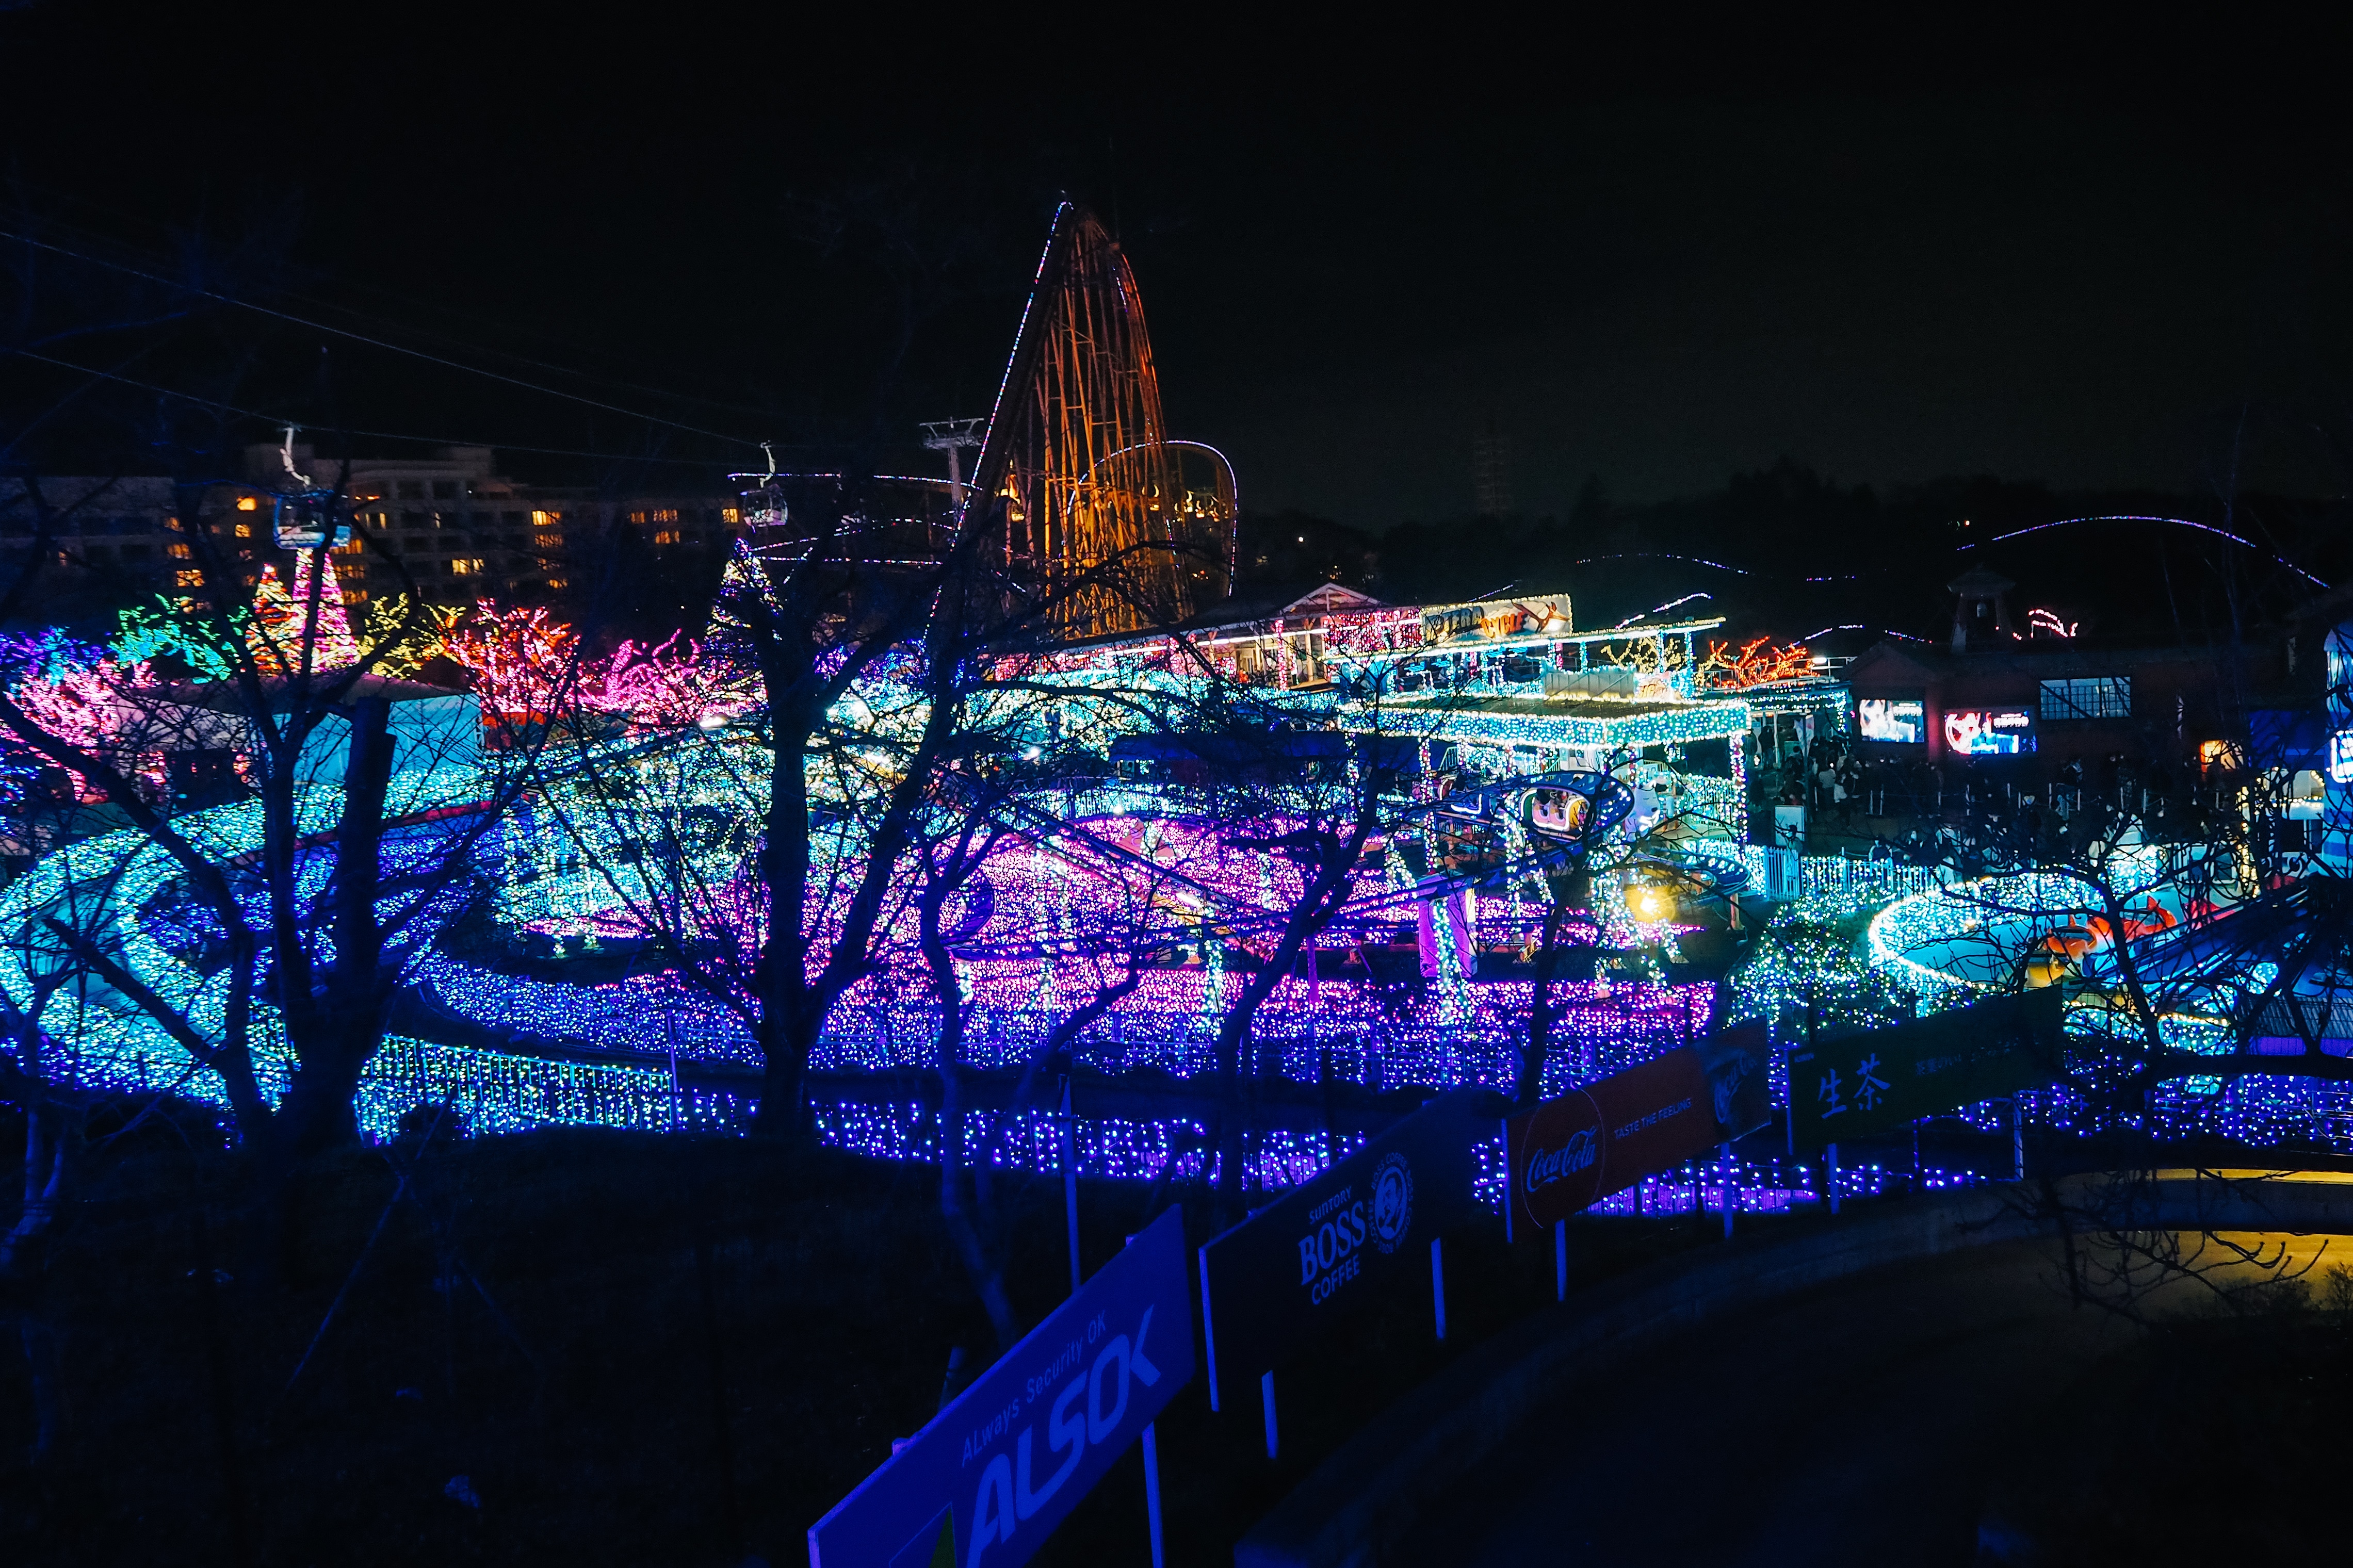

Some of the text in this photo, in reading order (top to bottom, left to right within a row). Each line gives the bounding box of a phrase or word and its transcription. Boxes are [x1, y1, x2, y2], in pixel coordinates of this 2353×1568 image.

[1425, 606, 1524, 641] PTERA CYCLE
[1614, 1097, 1692, 1139] TASTE THE FEELING
[1818, 1052, 1891, 1120] 生茶
[1297, 1200, 1366, 1286] BOSS
[1311, 1253, 1360, 1306] COFFEE
[1026, 1335, 1084, 1404] Security
[1086, 1309, 1107, 1344] OK
[966, 1304, 1162, 1568] ALSOK
